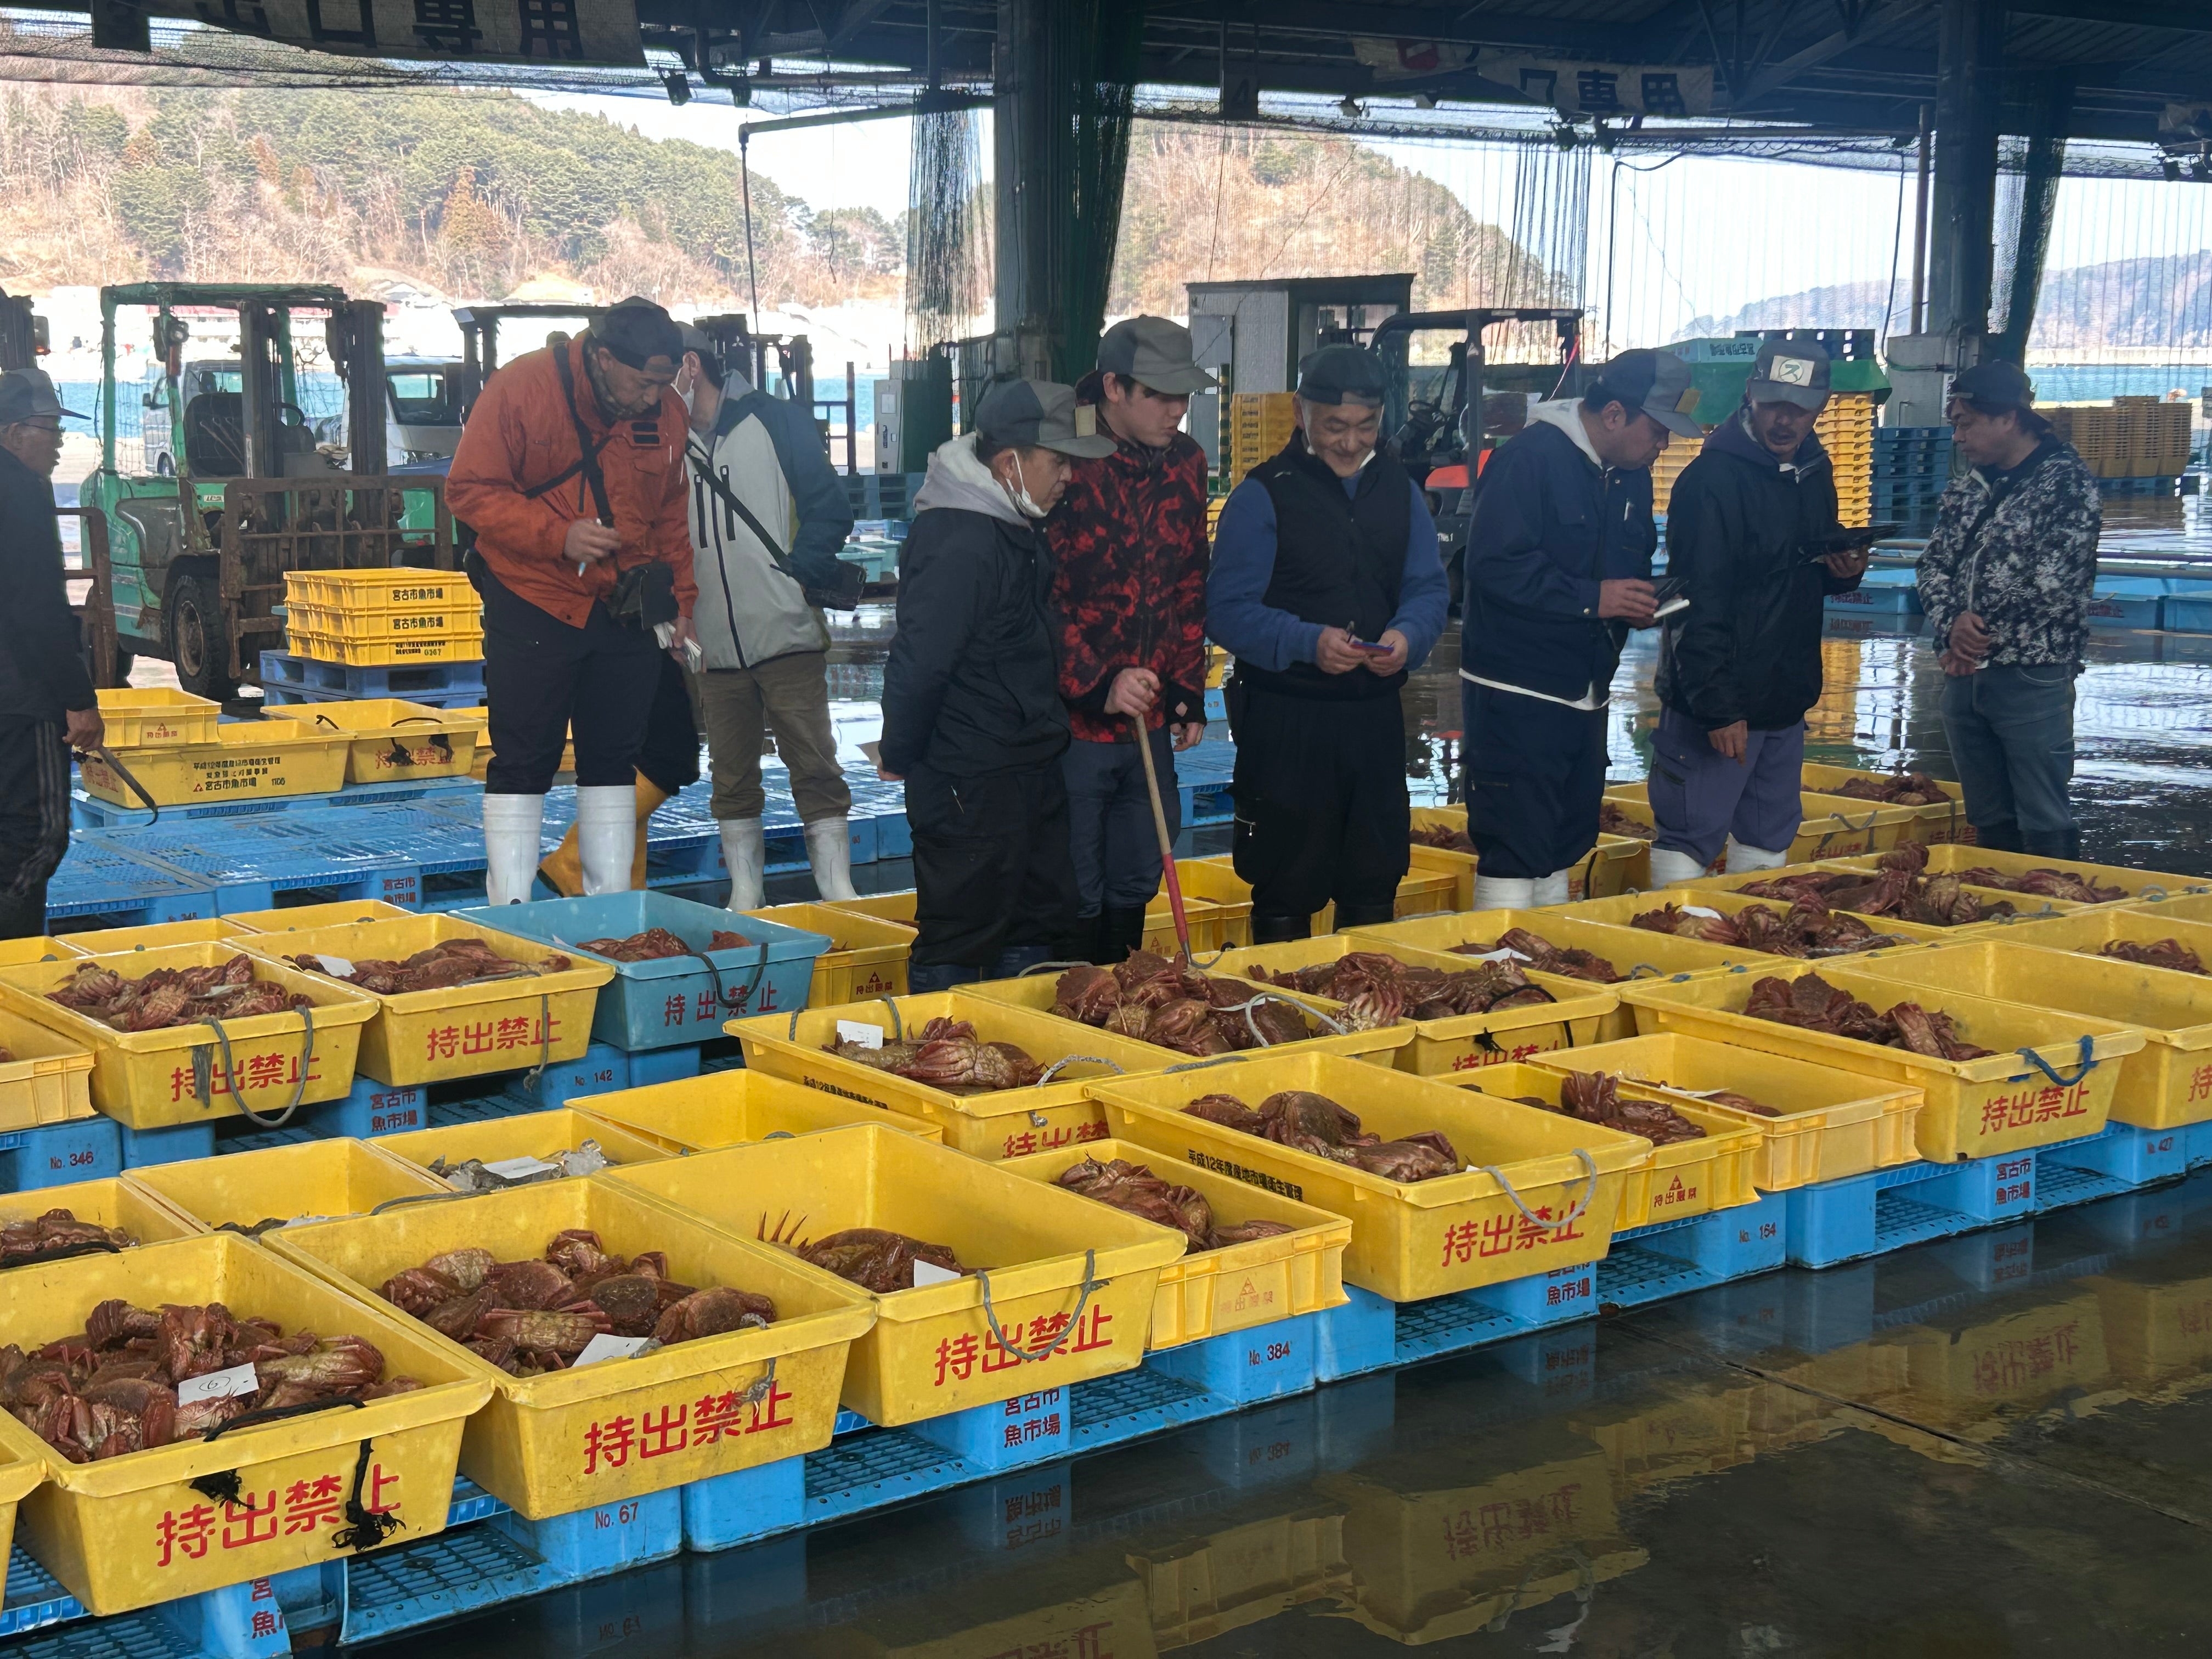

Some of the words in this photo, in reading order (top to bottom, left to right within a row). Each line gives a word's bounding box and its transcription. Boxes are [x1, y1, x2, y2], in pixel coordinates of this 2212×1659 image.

[664, 981, 778, 1028] 持出禁止
[426, 1012, 562, 1061] 持出禁止
[171, 1052, 321, 1102] 持出禁止
[595, 1069, 612, 1083] 142
[370, 1088, 416, 1110] 宮古市
[1979, 1082, 2090, 1136] 持出禁止
[371, 1109, 417, 1132] 魚市場
[1442, 1200, 1585, 1267] 持出禁止
[1759, 1222, 1776, 1240] 164
[1546, 1277, 1590, 1306] 魚市場
[934, 1305, 1113, 1387] 持出禁止
[1267, 1340, 1290, 1361] 384
[584, 1380, 793, 1474] 持出禁止
[1004, 1413, 1060, 1448] 魚市場
[156, 1463, 402, 1567] 持出禁止
[595, 1510, 614, 1530] No.
[619, 1502, 639, 1523] 67
